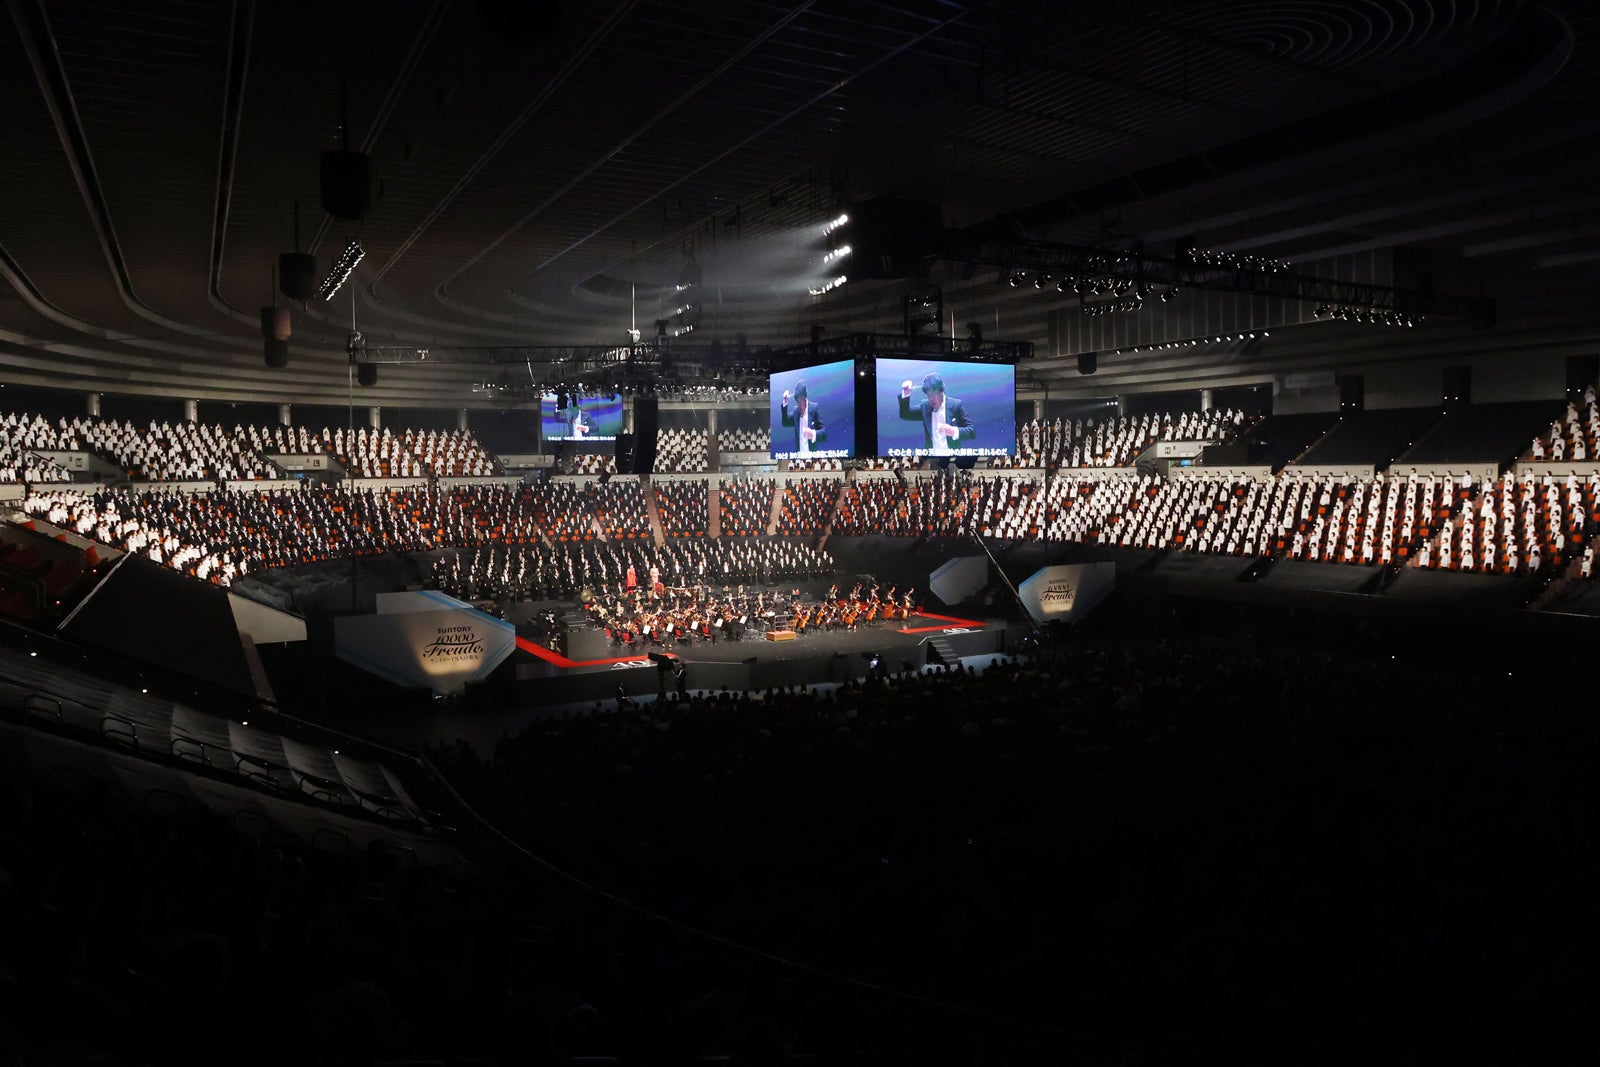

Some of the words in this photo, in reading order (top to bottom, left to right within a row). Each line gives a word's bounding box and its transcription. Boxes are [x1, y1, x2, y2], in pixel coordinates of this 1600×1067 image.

[888, 448, 912, 456] そのとき
[438, 626, 472, 634] SUNTORY
[435, 633, 475, 644] 10000
[423, 640, 484, 657] Freude
